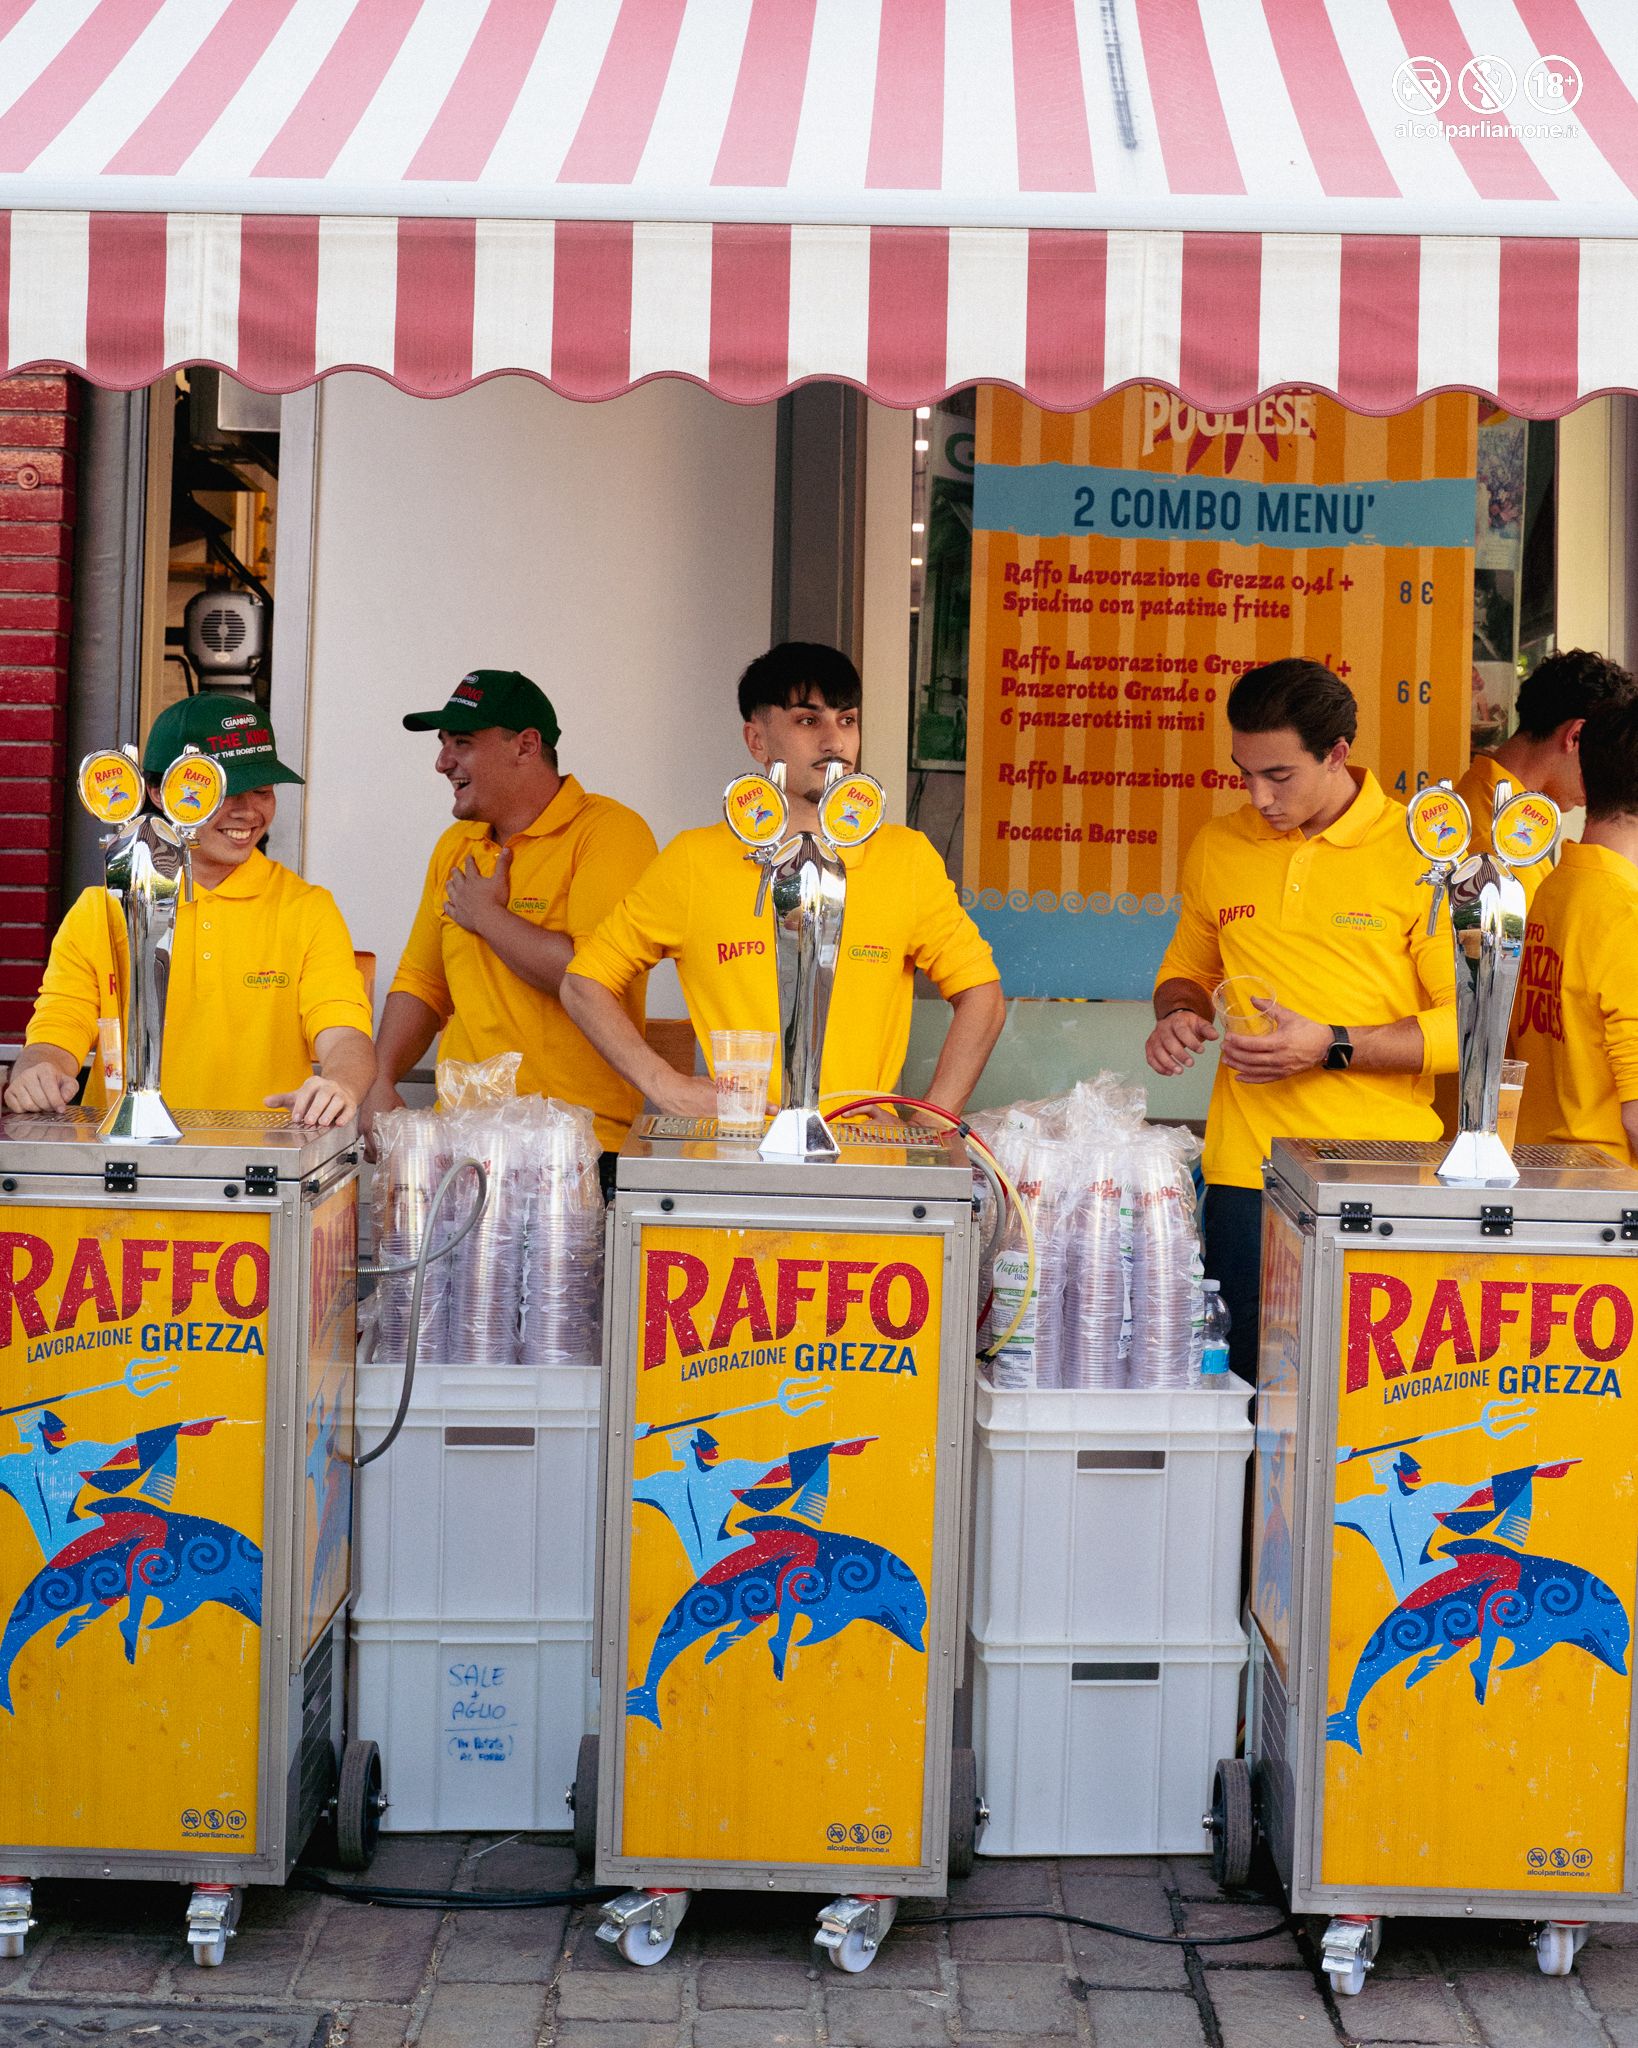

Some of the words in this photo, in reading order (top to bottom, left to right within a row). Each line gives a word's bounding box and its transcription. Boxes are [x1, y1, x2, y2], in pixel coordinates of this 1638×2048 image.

[1074, 486, 1095, 527] 2
[1111, 487, 1241, 531] COMBO
[1257, 491, 1375, 534] MENU'
[1004, 560, 1063, 589] Raffo
[1068, 564, 1200, 588] Lavorazione
[1206, 568, 1286, 590] Grezza
[1339, 574, 1354, 591] +
[1400, 580, 1412, 604] 8
[1421, 581, 1434, 605] €
[1003, 589, 1094, 617] Spiedino
[1099, 598, 1135, 614] con
[1140, 597, 1228, 621] patatine
[1233, 594, 1290, 624] fritte
[1002, 646, 1060, 675] Raffo
[1066, 650, 1198, 673] Lavorazione
[1001, 677, 1118, 700] Panzerotto
[1124, 679, 1199, 703] Grande
[1205, 687, 1217, 702] o
[1397, 680, 1410, 704] 6
[1419, 681, 1432, 704] €
[1000, 707, 1013, 726] 6
[1019, 710, 1152, 732] panzerottini
[1158, 711, 1206, 731] mini
[207, 732, 242, 752] THE
[221, 750, 235, 758] THE
[236, 746, 256, 756] ROAST
[95, 767, 122, 784] RAFFO
[184, 768, 211, 785] RAFFO
[998, 761, 1057, 790] Raffo
[1062, 765, 1195, 788] Lavorazione
[1201, 769, 1246, 790] Grez
[1394, 770, 1407, 794] 4
[1417, 771, 1429, 790] €
[737, 787, 763, 807] RAFFO
[847, 786, 874, 807] RAFFO
[1422, 803, 1449, 822] RAFFO
[1521, 804, 1549, 825] RAFFO
[997, 820, 1083, 843] Focaccia
[1088, 823, 1158, 845] Barese
[1219, 904, 1255, 929] RAFFO
[717, 941, 765, 965] RAFFO
[0, 1231, 270, 1350] RAFFO
[644, 1250, 929, 1371] RAFFO
[27, 1327, 133, 1363] LAVORAZIONE
[141, 1322, 265, 1355] GREZZA
[1346, 1272, 1634, 1395] RAFFO
[681, 1347, 787, 1382] LAVORAZIONE
[795, 1343, 918, 1376] GREZZA
[1384, 1369, 1490, 1404] LAVORAZIONE
[1498, 1365, 1622, 1398] GREZZA
[448, 1664, 507, 1688] SALE
